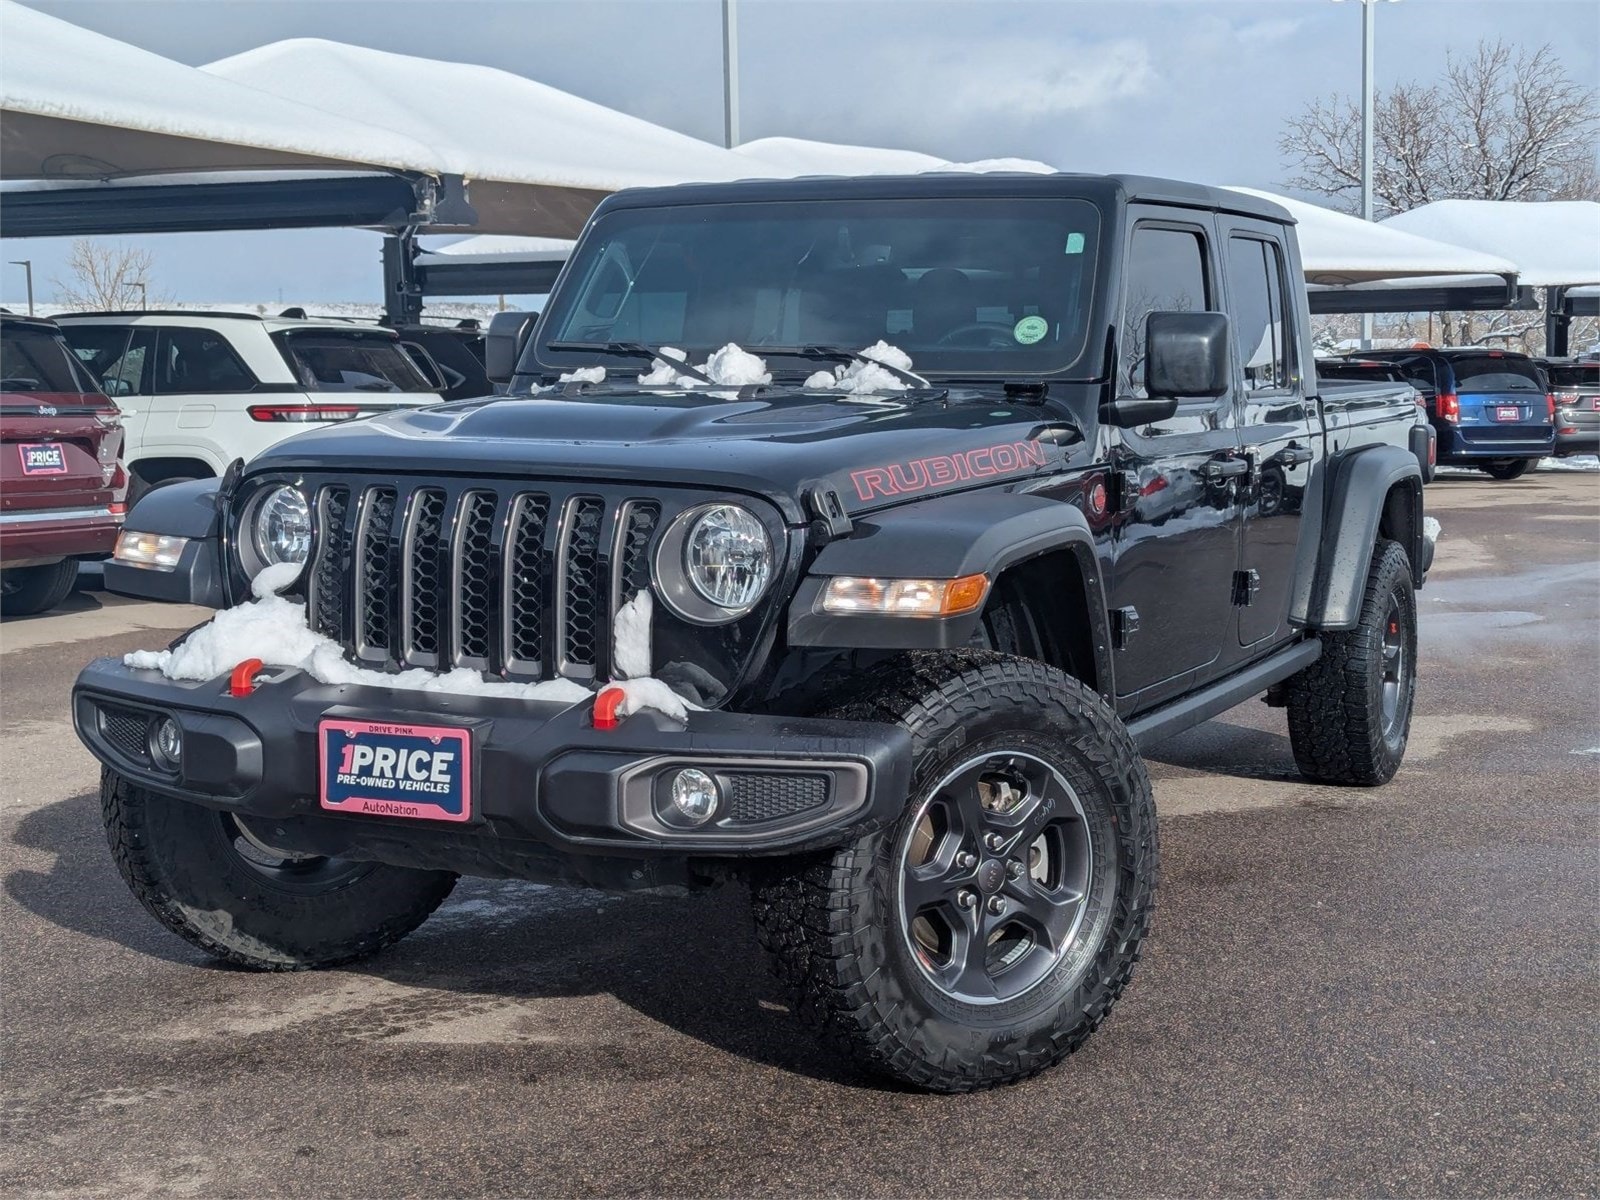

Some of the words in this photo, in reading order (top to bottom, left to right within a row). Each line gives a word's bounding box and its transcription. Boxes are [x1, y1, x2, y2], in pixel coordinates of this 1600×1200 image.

[38, 405, 57, 416] Jeep
[850, 439, 1047, 501] RUBICON
[368, 725, 393, 734] DRIVE
[395, 727, 414, 735] PINK
[336, 774, 396, 789] PRE-OWNED
[399, 779, 450, 794] VEHICLES
[362, 801, 418, 816] AutoNation
